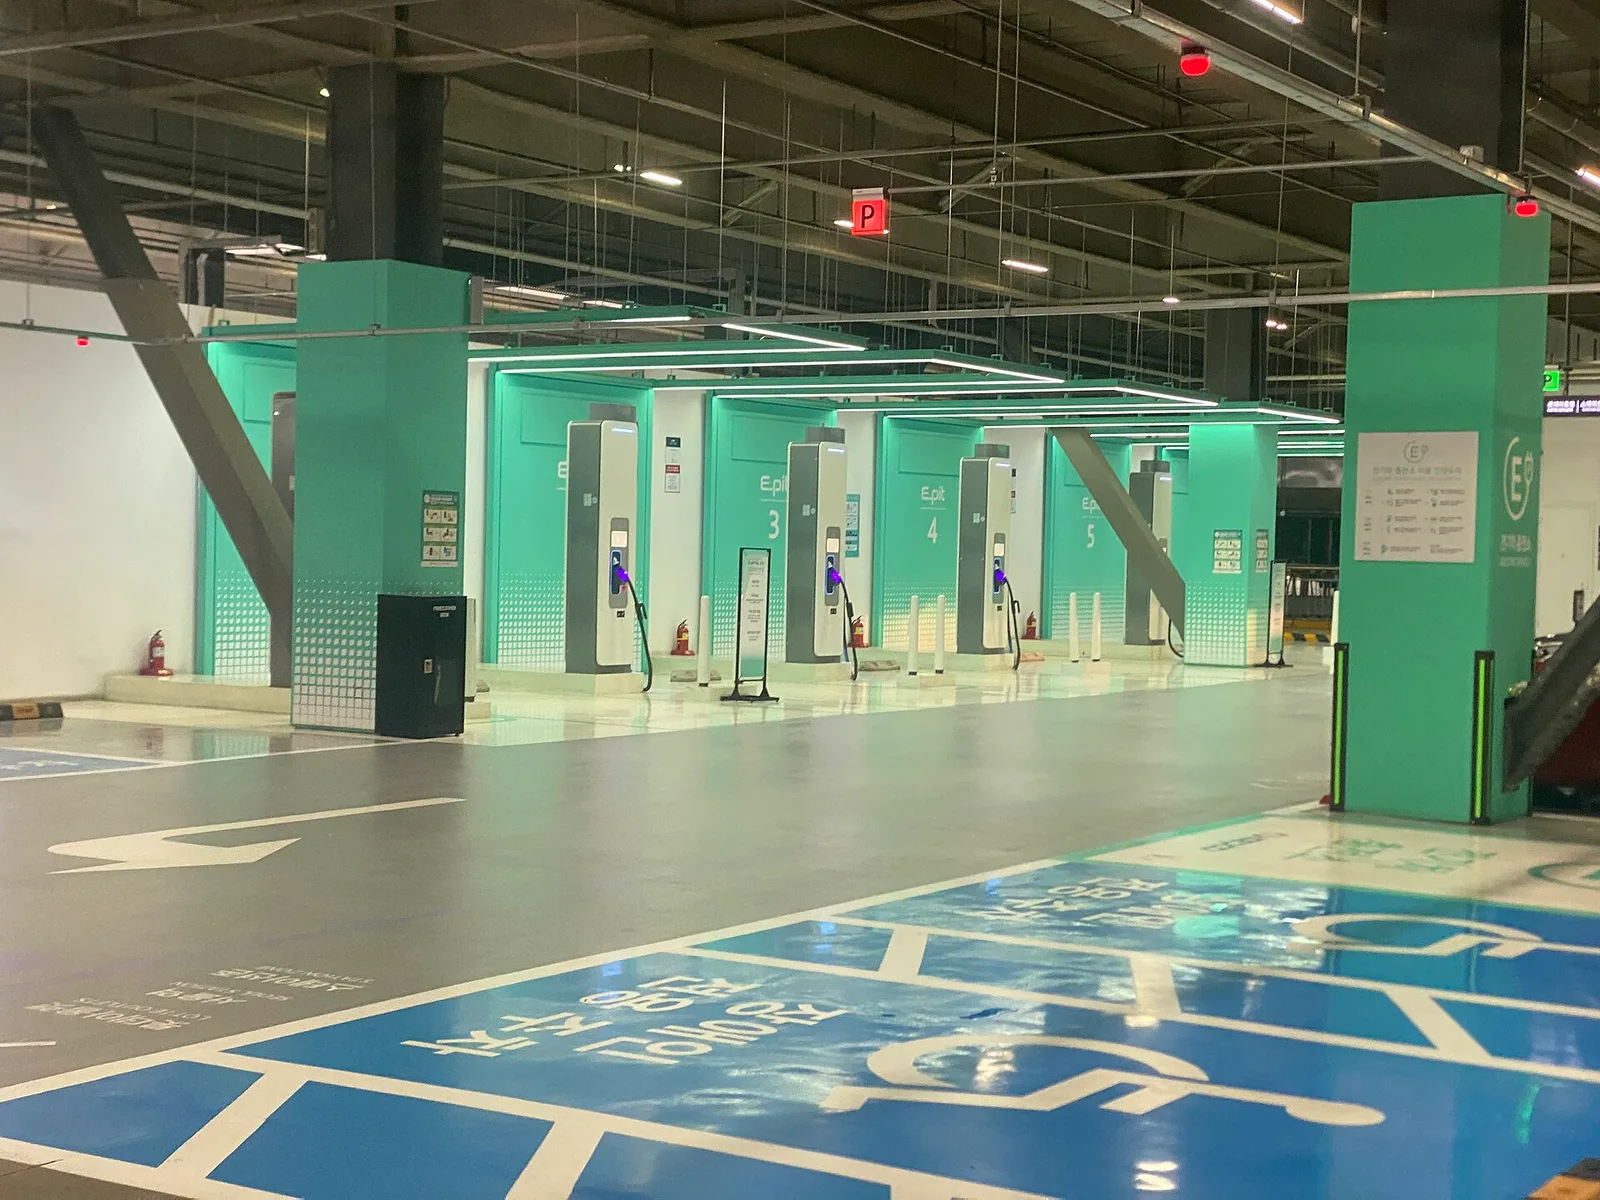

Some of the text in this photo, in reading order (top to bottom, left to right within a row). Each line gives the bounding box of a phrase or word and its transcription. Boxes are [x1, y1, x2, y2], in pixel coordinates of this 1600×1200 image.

[861, 204, 875, 229] P
[768, 509, 780, 540] 3
[927, 516, 938, 545] 4
[1087, 524, 1095, 549] 5
[399, 975, 763, 1058] 전용 주차
[573, 1000, 850, 1065] 장애인
